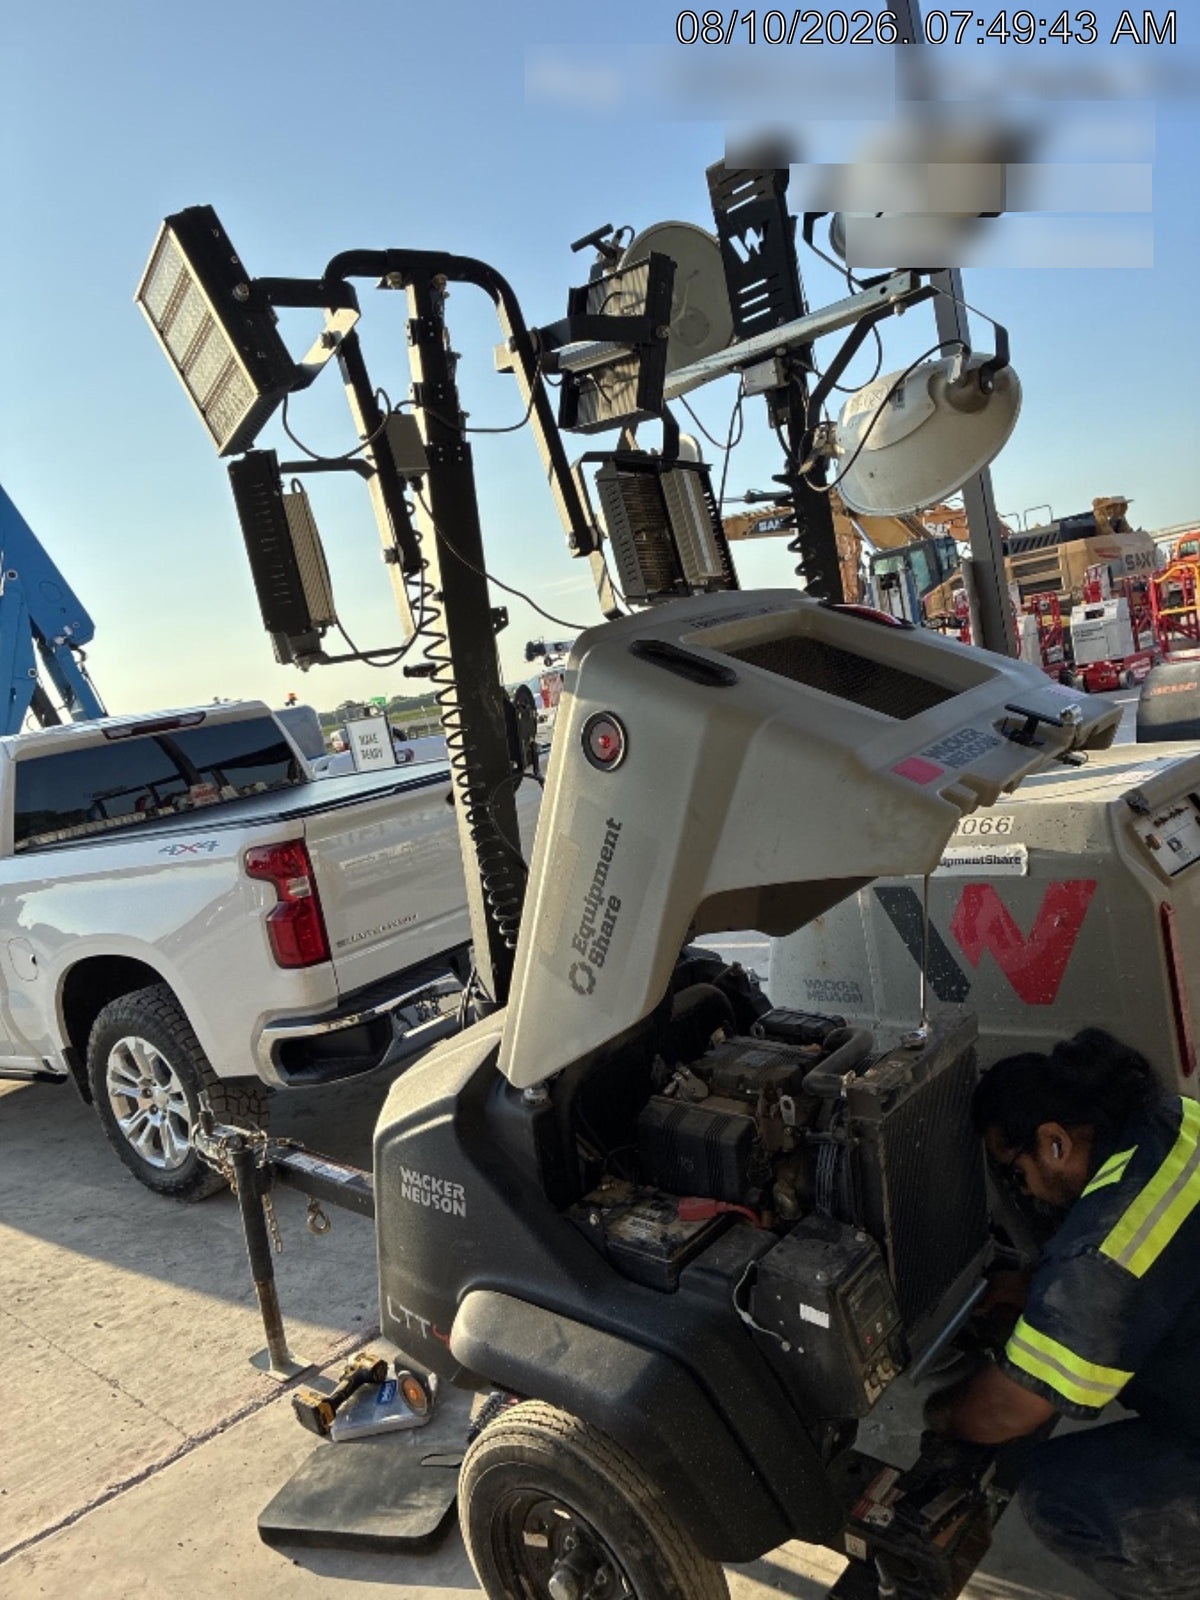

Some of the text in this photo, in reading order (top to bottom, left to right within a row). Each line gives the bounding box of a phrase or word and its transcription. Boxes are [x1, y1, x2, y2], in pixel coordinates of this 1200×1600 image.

[952, 817, 1011, 835] 066
[572, 817, 623, 957] Equipment
[588, 894, 622, 969] Share
[400, 1165, 465, 1200] WACKER
[401, 1182, 466, 1218] NEUSON
